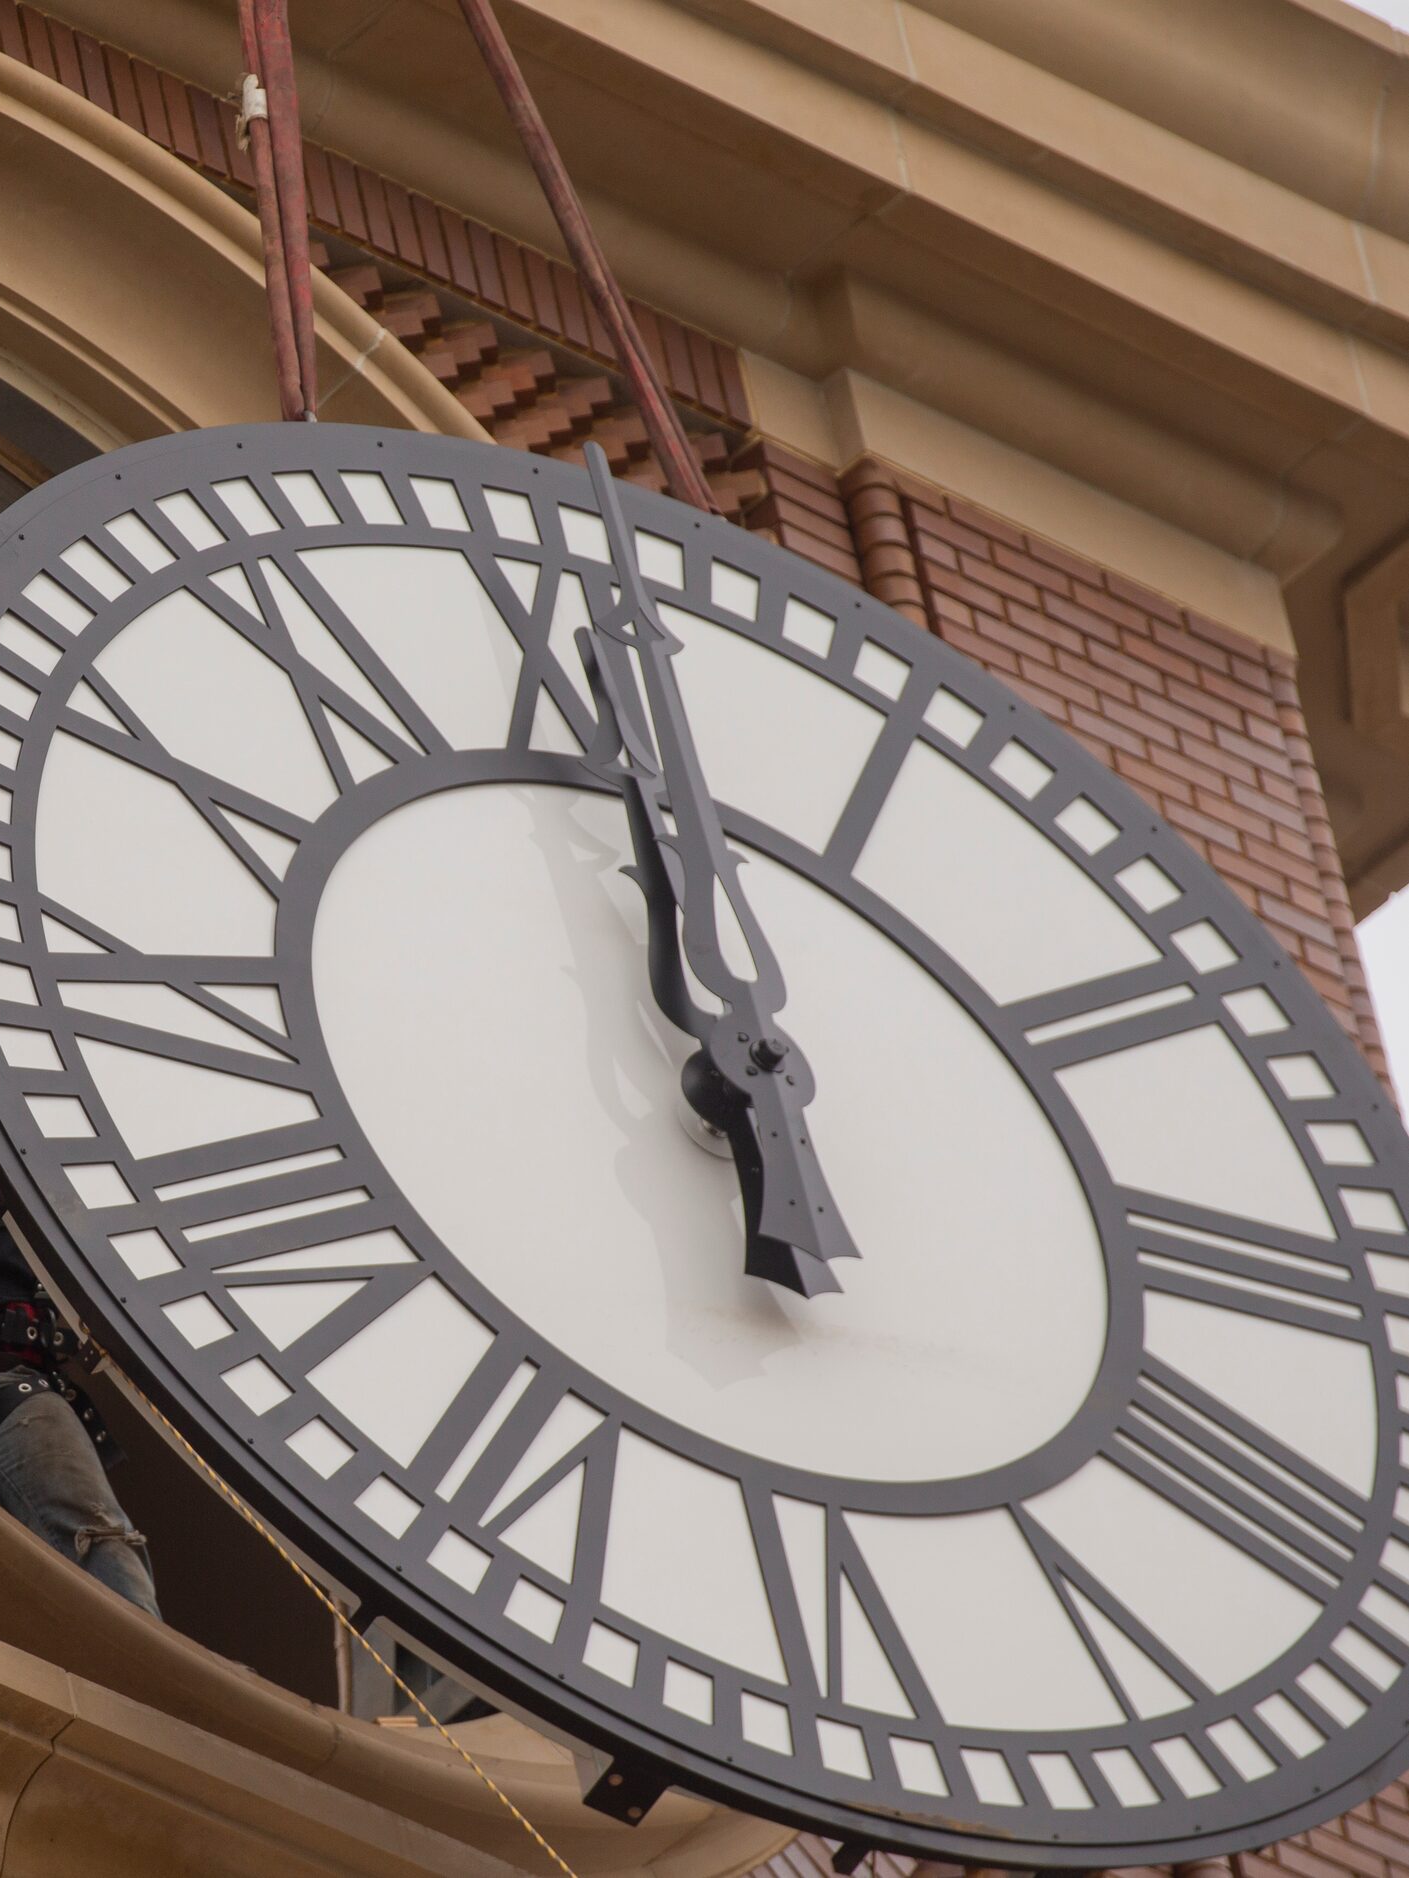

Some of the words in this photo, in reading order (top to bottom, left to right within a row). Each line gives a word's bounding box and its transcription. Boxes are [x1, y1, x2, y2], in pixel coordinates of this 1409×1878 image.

[57, 663, 315, 899] X
[184, 550, 454, 795] XI
[460, 549, 710, 798] XI
[822, 716, 918, 878] I
[38, 891, 312, 1093] IX
[999, 958, 1220, 1069] II
[135, 1116, 434, 1376] VIII
[1114, 1184, 1370, 1344] III
[406, 1334, 621, 1603] VII
[1098, 1350, 1370, 1605] IIII
[740, 1477, 946, 1725] VI
[1007, 1502, 1216, 1722] V
